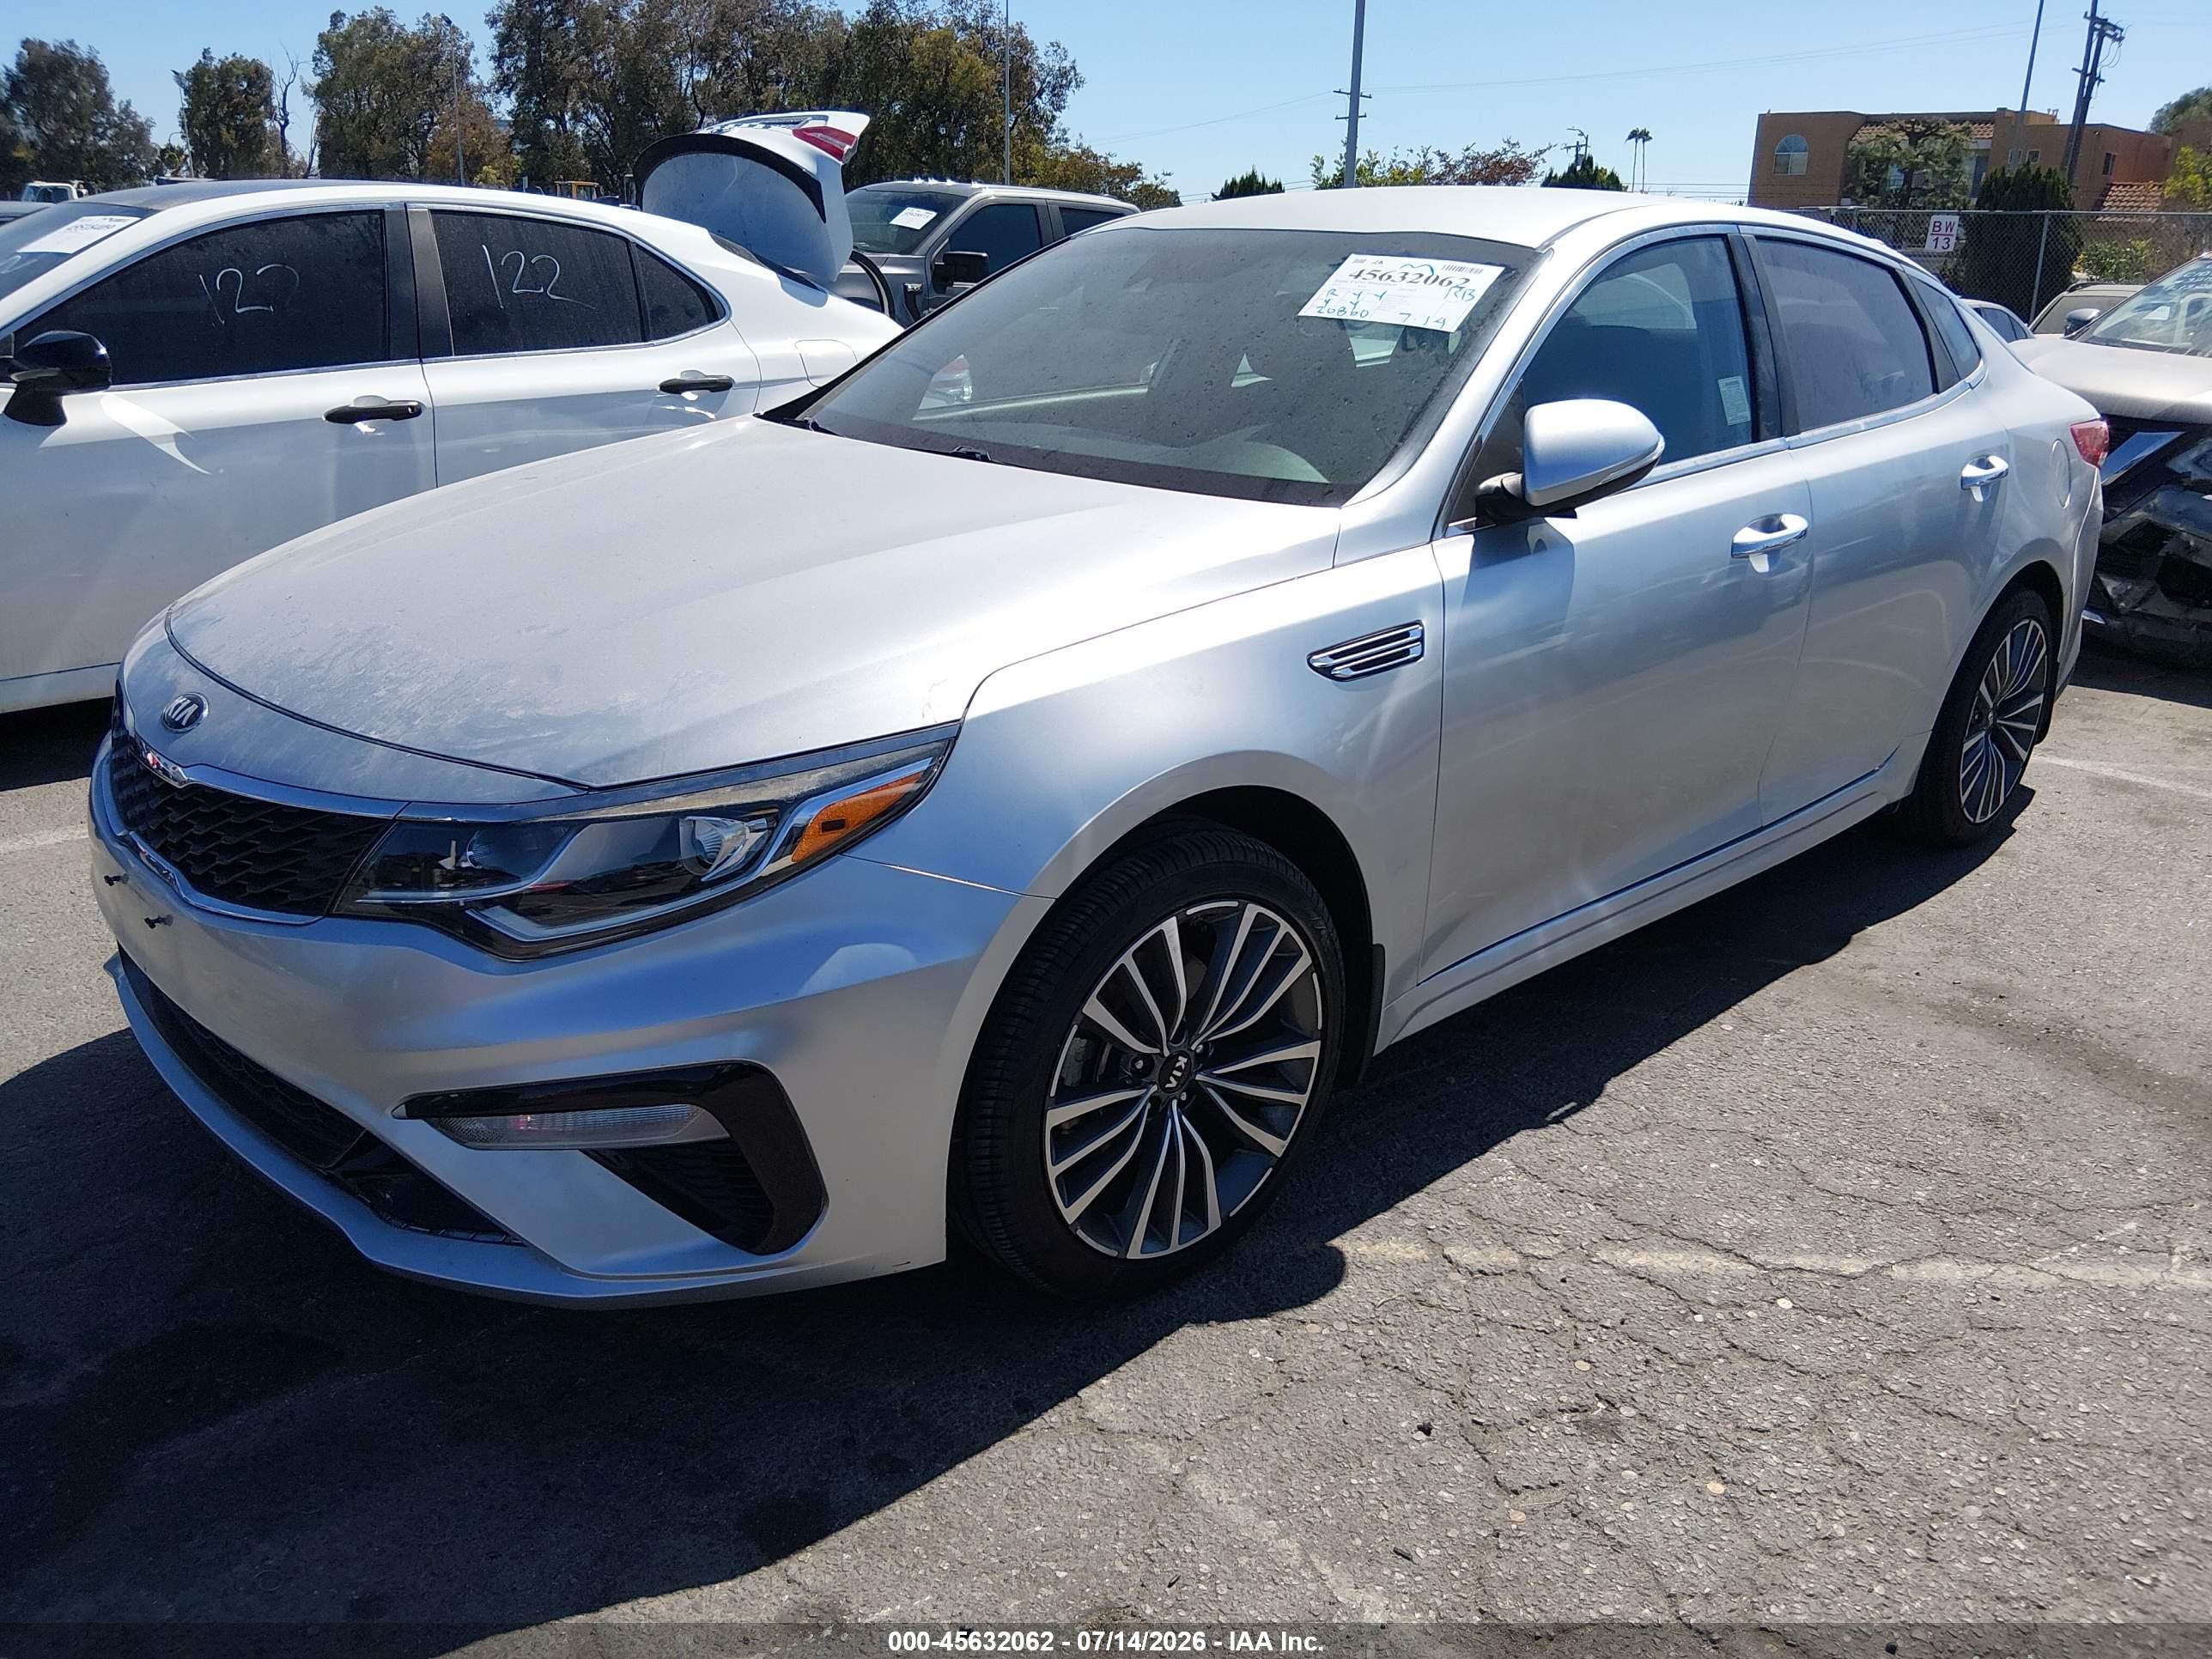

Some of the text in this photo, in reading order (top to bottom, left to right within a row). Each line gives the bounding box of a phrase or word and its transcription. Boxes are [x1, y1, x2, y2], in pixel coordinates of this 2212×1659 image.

[1932, 221, 1955, 233] BW
[1932, 237, 1951, 250] 13
[483, 244, 597, 310] 122
[1348, 269, 1470, 289] 45632062
[1164, 1055, 1188, 1088] KIA
